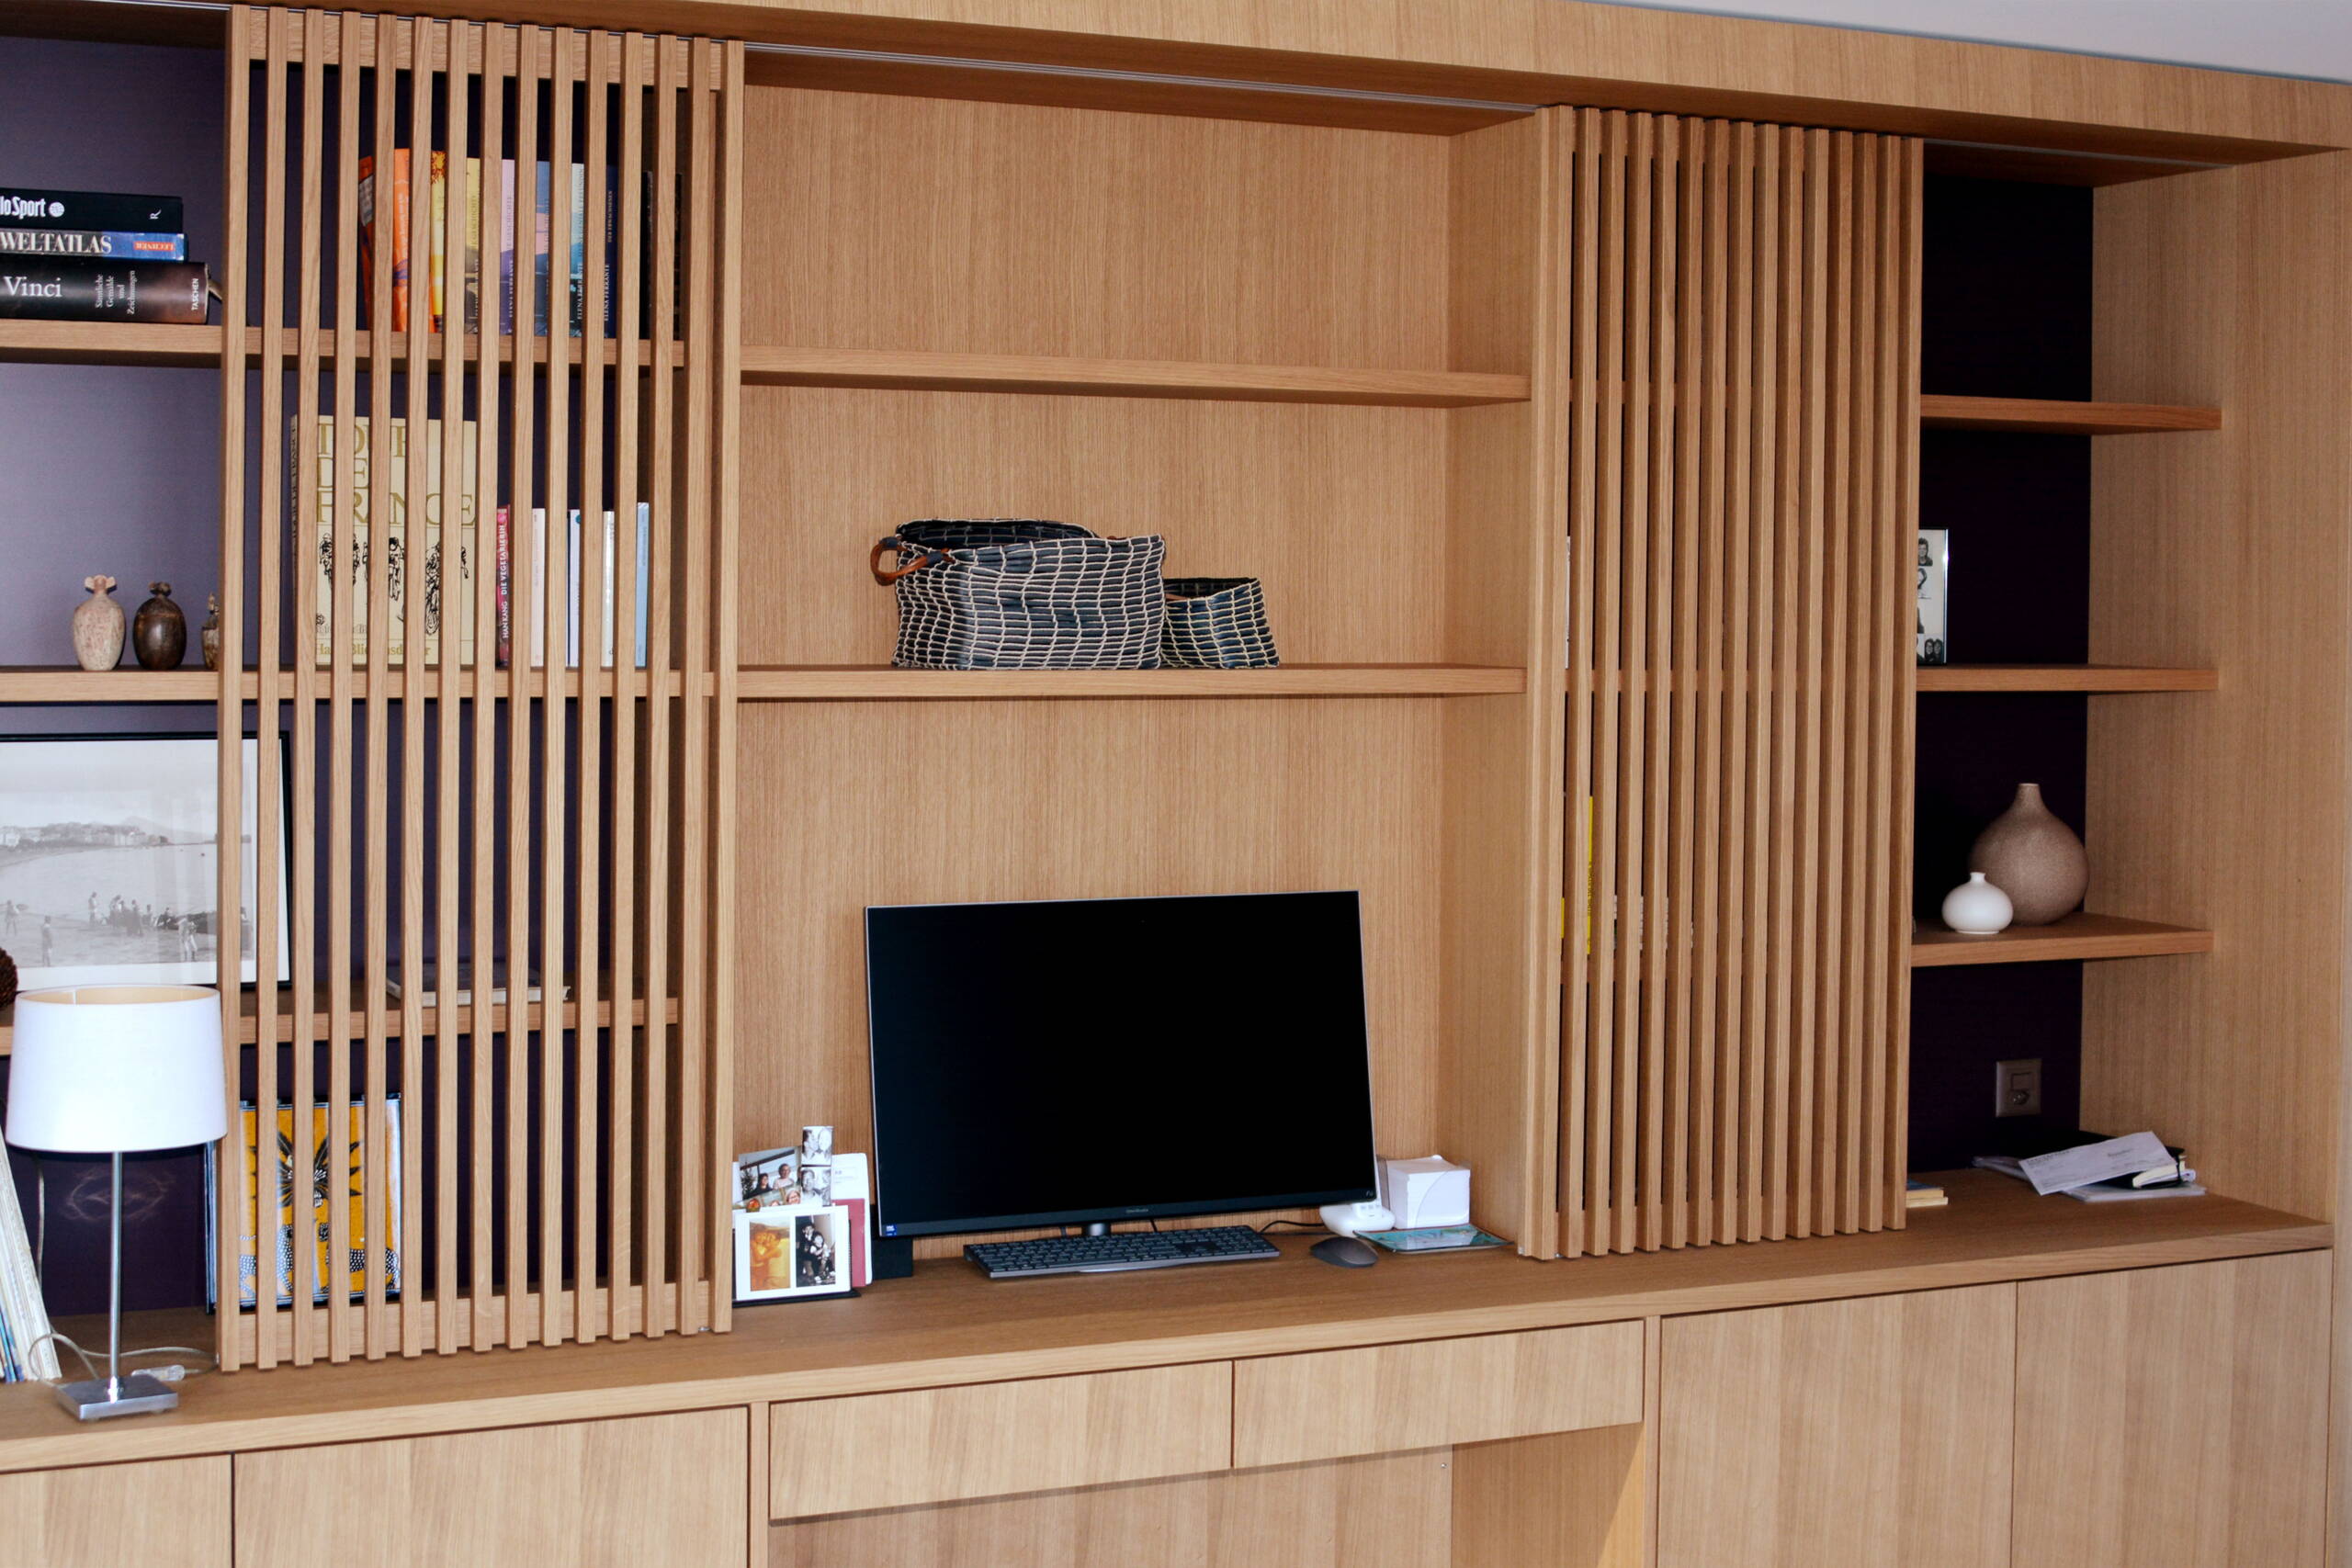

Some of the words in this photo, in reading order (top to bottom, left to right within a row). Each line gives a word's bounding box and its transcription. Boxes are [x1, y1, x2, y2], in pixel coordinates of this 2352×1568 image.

[0, 231, 112, 254] WELTATLAS
[3, 276, 62, 297] Vinci
[191, 277, 199, 310] TASCHEN
[316, 490, 476, 526] FRNCE
[497, 524, 507, 581] VEGETARIERIN
